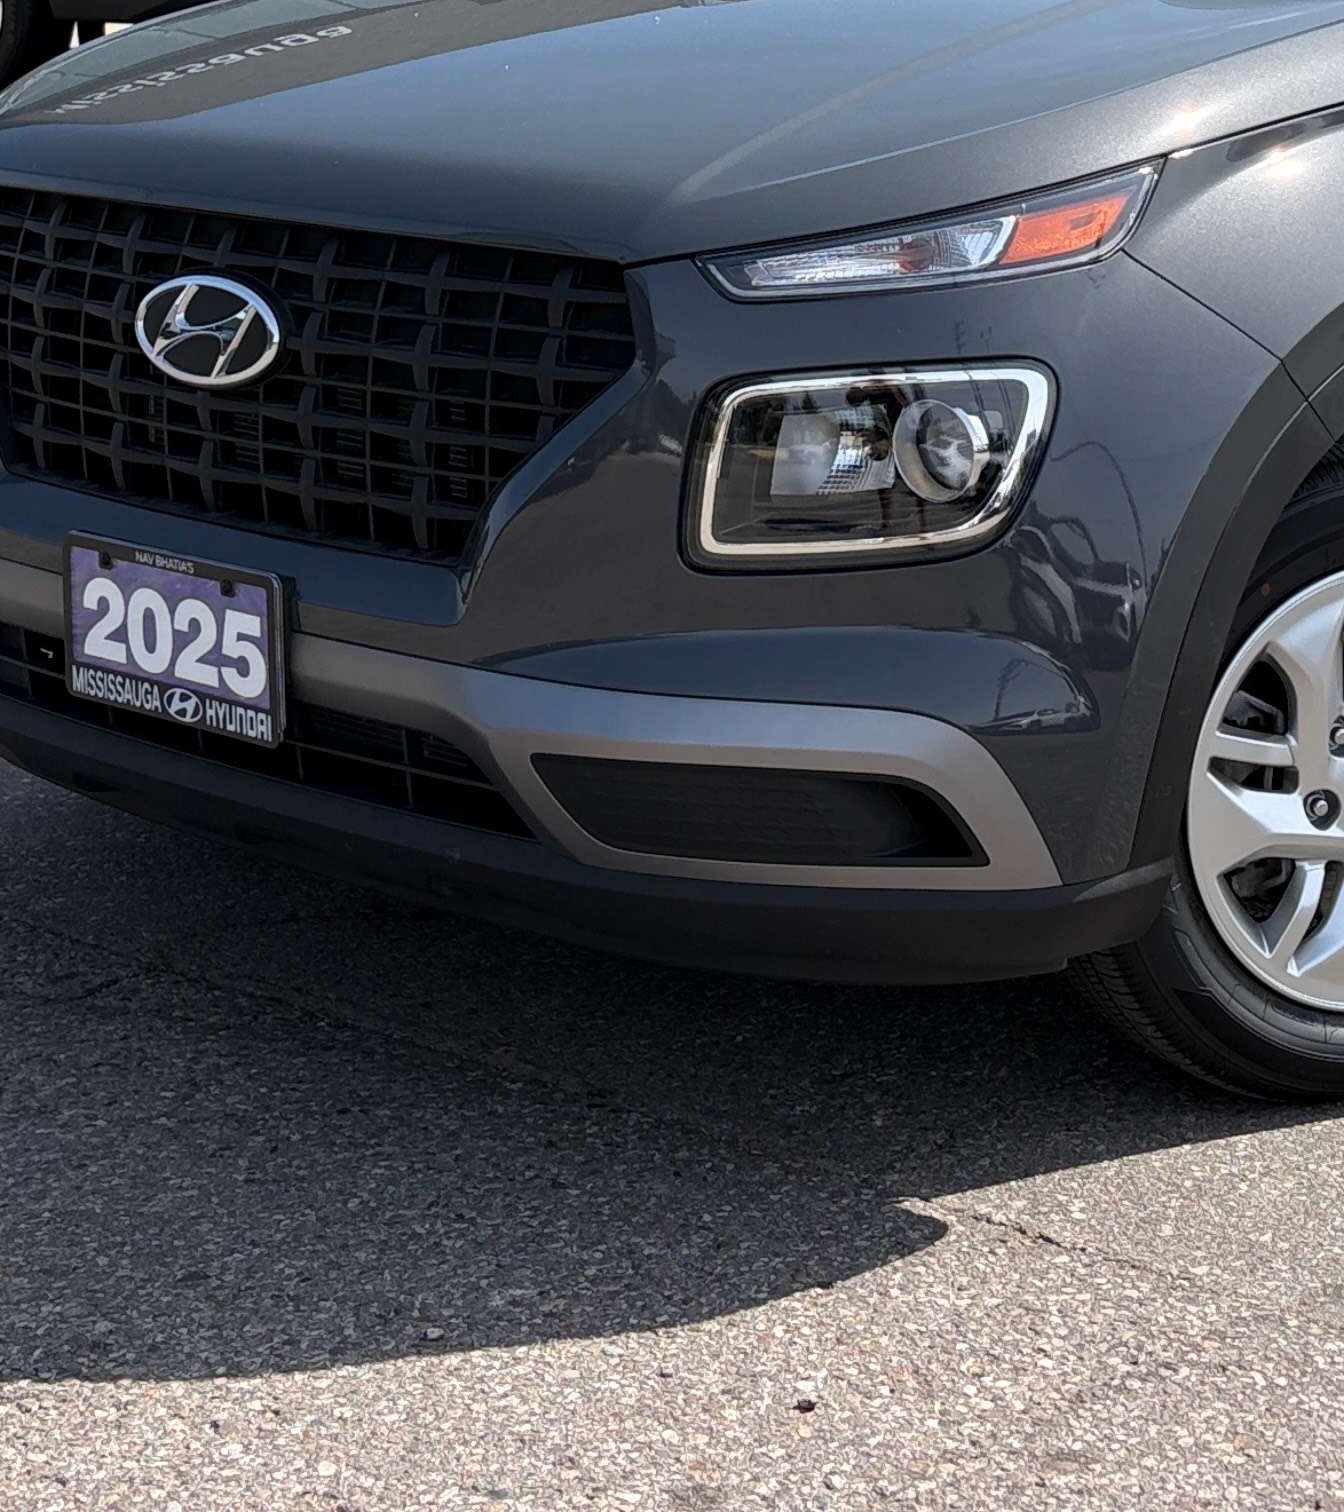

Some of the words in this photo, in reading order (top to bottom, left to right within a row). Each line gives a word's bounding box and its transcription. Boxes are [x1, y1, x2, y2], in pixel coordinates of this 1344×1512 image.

[135, 550, 154, 565] NAV
[83, 577, 268, 698] 2025
[71, 664, 163, 714] MISSISSAUGA
[205, 698, 273, 743] HYUNDAI
